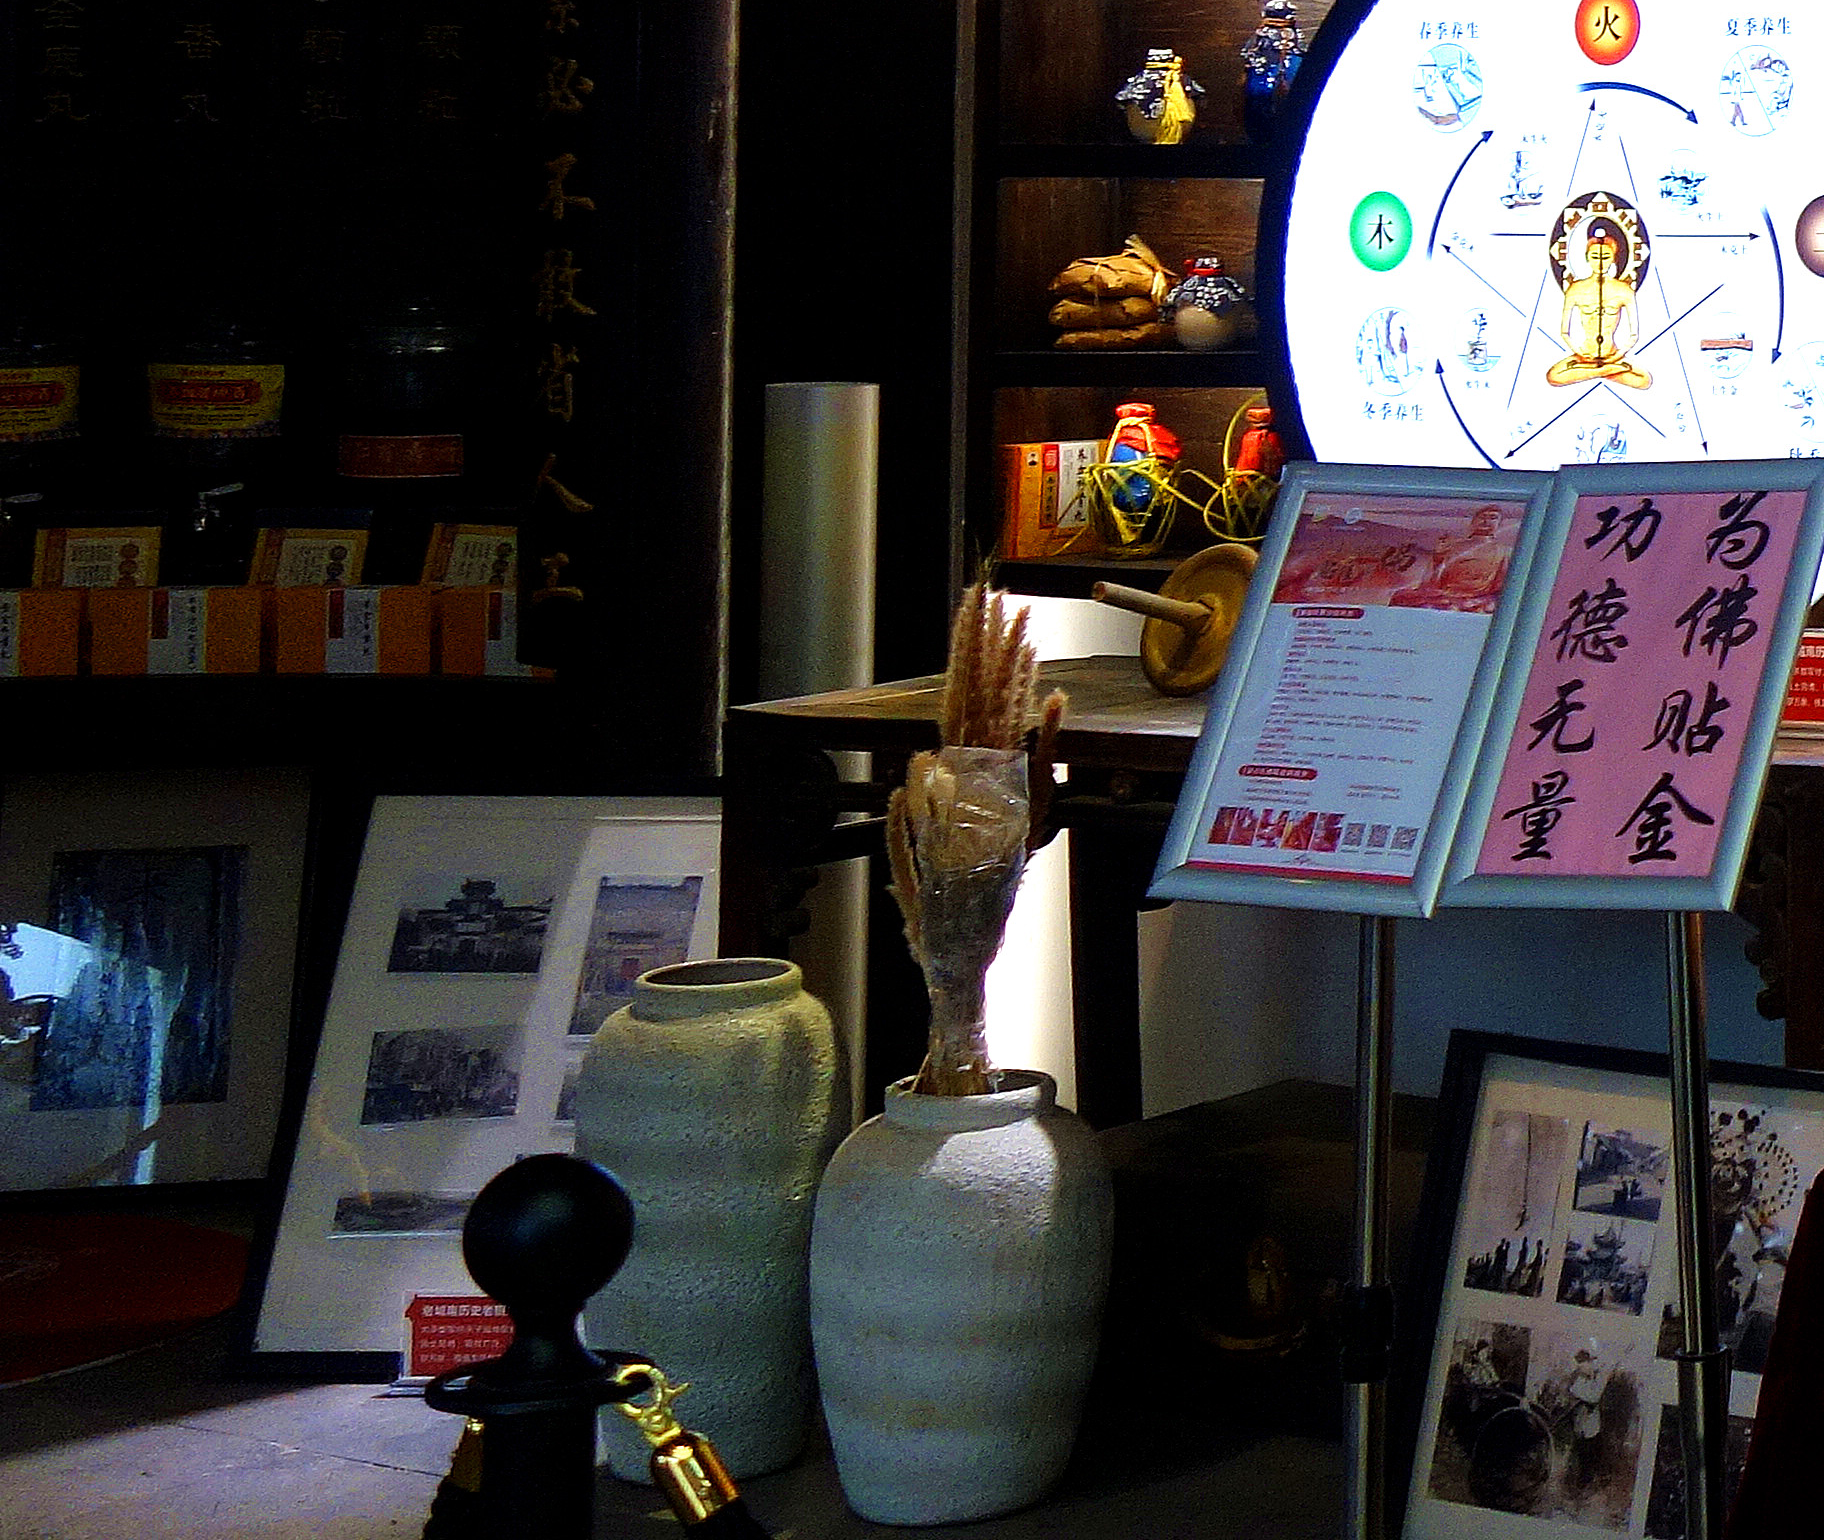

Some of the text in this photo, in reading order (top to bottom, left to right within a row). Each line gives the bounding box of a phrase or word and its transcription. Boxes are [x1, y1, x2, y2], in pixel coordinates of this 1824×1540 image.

[1418, 21, 1480, 40] 春季养生
[1592, 5, 1622, 43] 火
[1725, 16, 1793, 37] 夏季养生
[1367, 214, 1396, 251] 木
[1500, 497, 1662, 862] 功德无量
[1616, 489, 1772, 866] 为佛贴金
